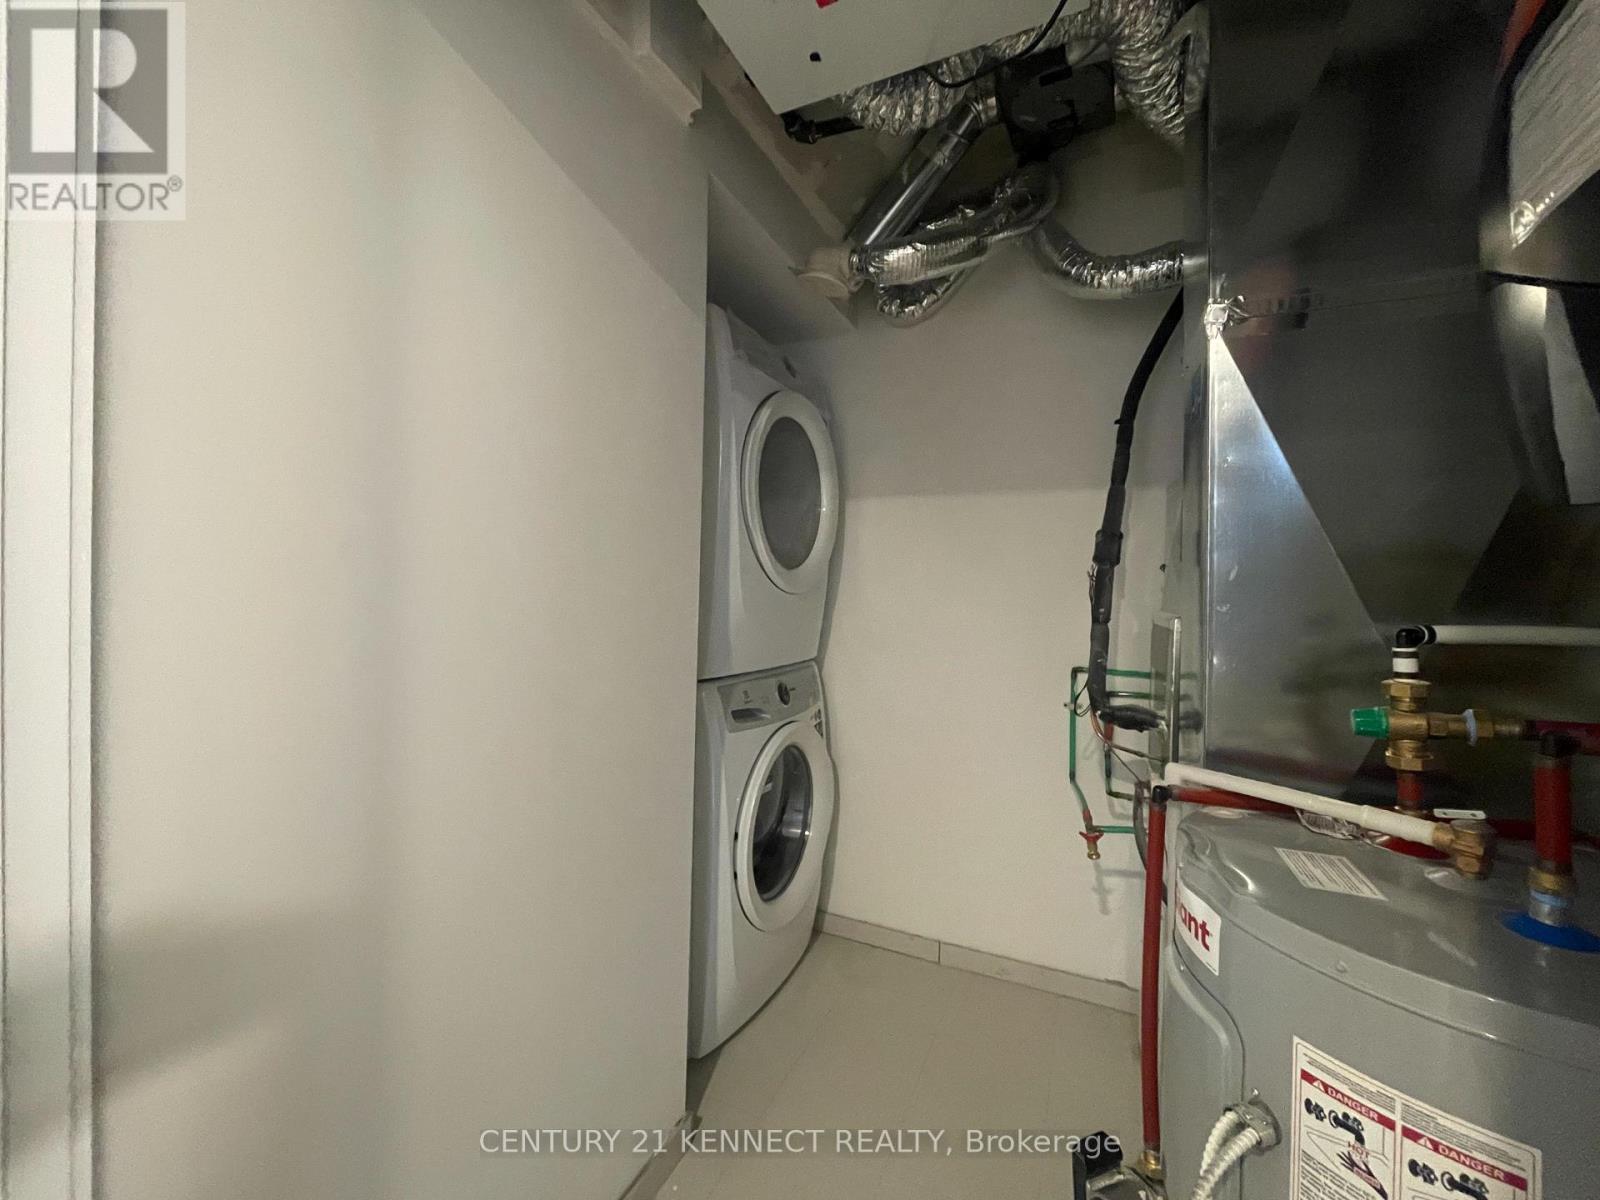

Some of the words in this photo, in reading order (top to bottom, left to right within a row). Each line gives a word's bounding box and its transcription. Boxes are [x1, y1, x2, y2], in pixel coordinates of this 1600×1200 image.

[1327, 1086, 1379, 1122] DANGER
[1347, 1141, 1370, 1160] HOT
[1437, 1145, 1506, 1182] DANGER
